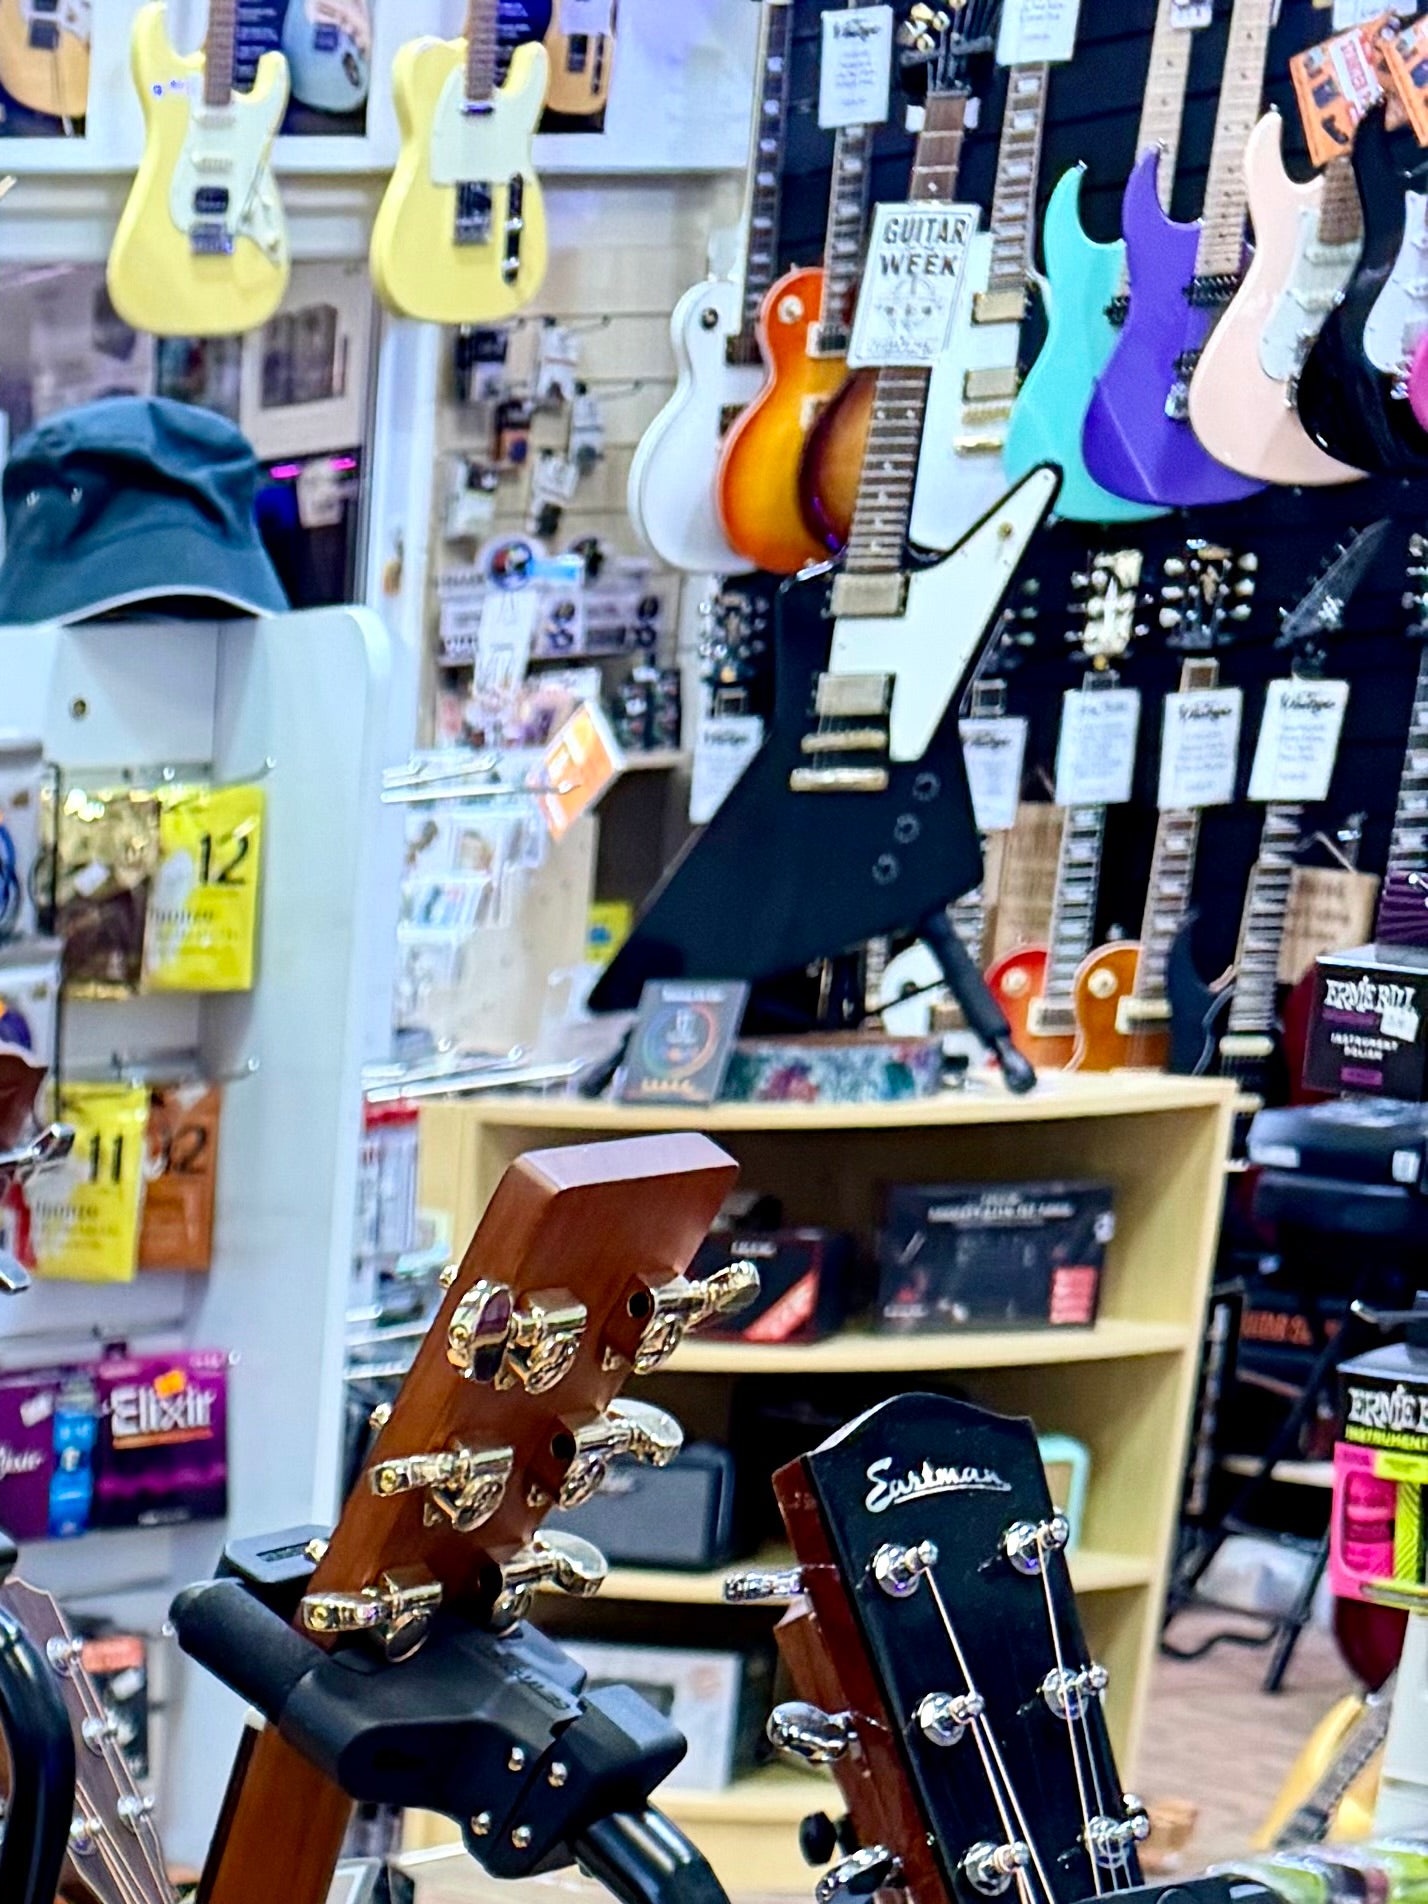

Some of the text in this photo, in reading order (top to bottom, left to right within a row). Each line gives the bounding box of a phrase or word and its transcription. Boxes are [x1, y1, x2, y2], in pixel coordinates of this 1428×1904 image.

[883, 217, 968, 246] GUITAR
[879, 253, 959, 278] WEEK
[200, 832, 250, 886] 12
[1324, 975, 1376, 1013] ERNIE
[90, 1131, 122, 1183] 11
[111, 1384, 216, 1435] Elixir
[1348, 1383, 1417, 1430] ERNIE
[865, 1456, 1012, 1513] Eastman
